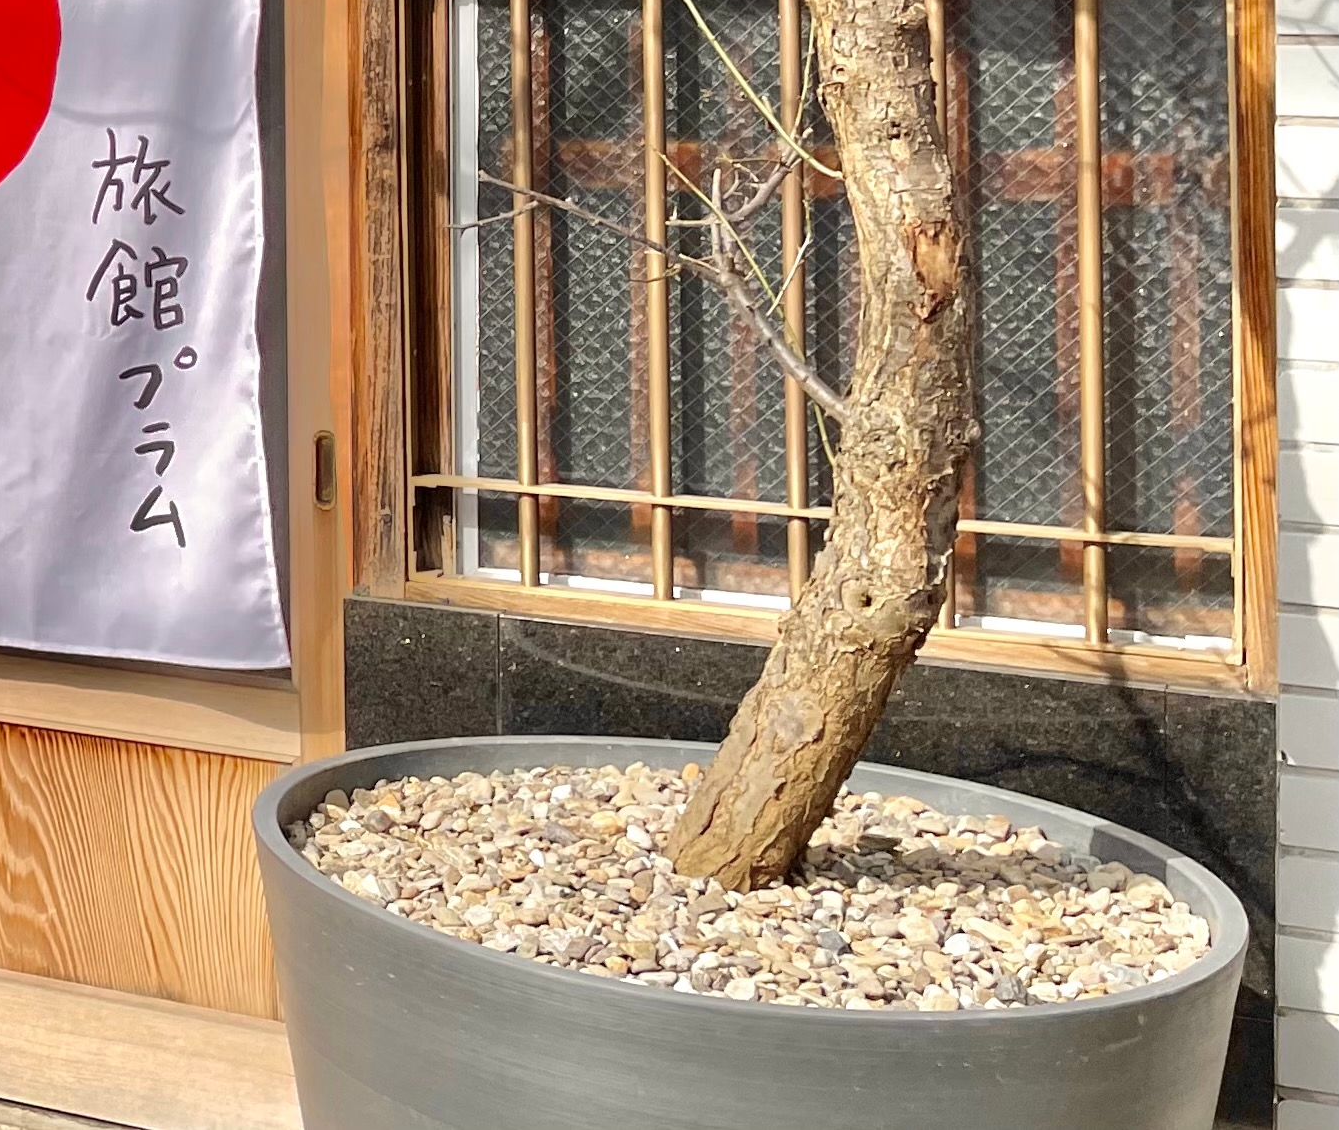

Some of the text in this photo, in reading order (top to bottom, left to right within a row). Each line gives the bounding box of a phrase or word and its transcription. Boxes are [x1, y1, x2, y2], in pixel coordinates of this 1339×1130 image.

[86, 127, 199, 548] 旅館プラム
